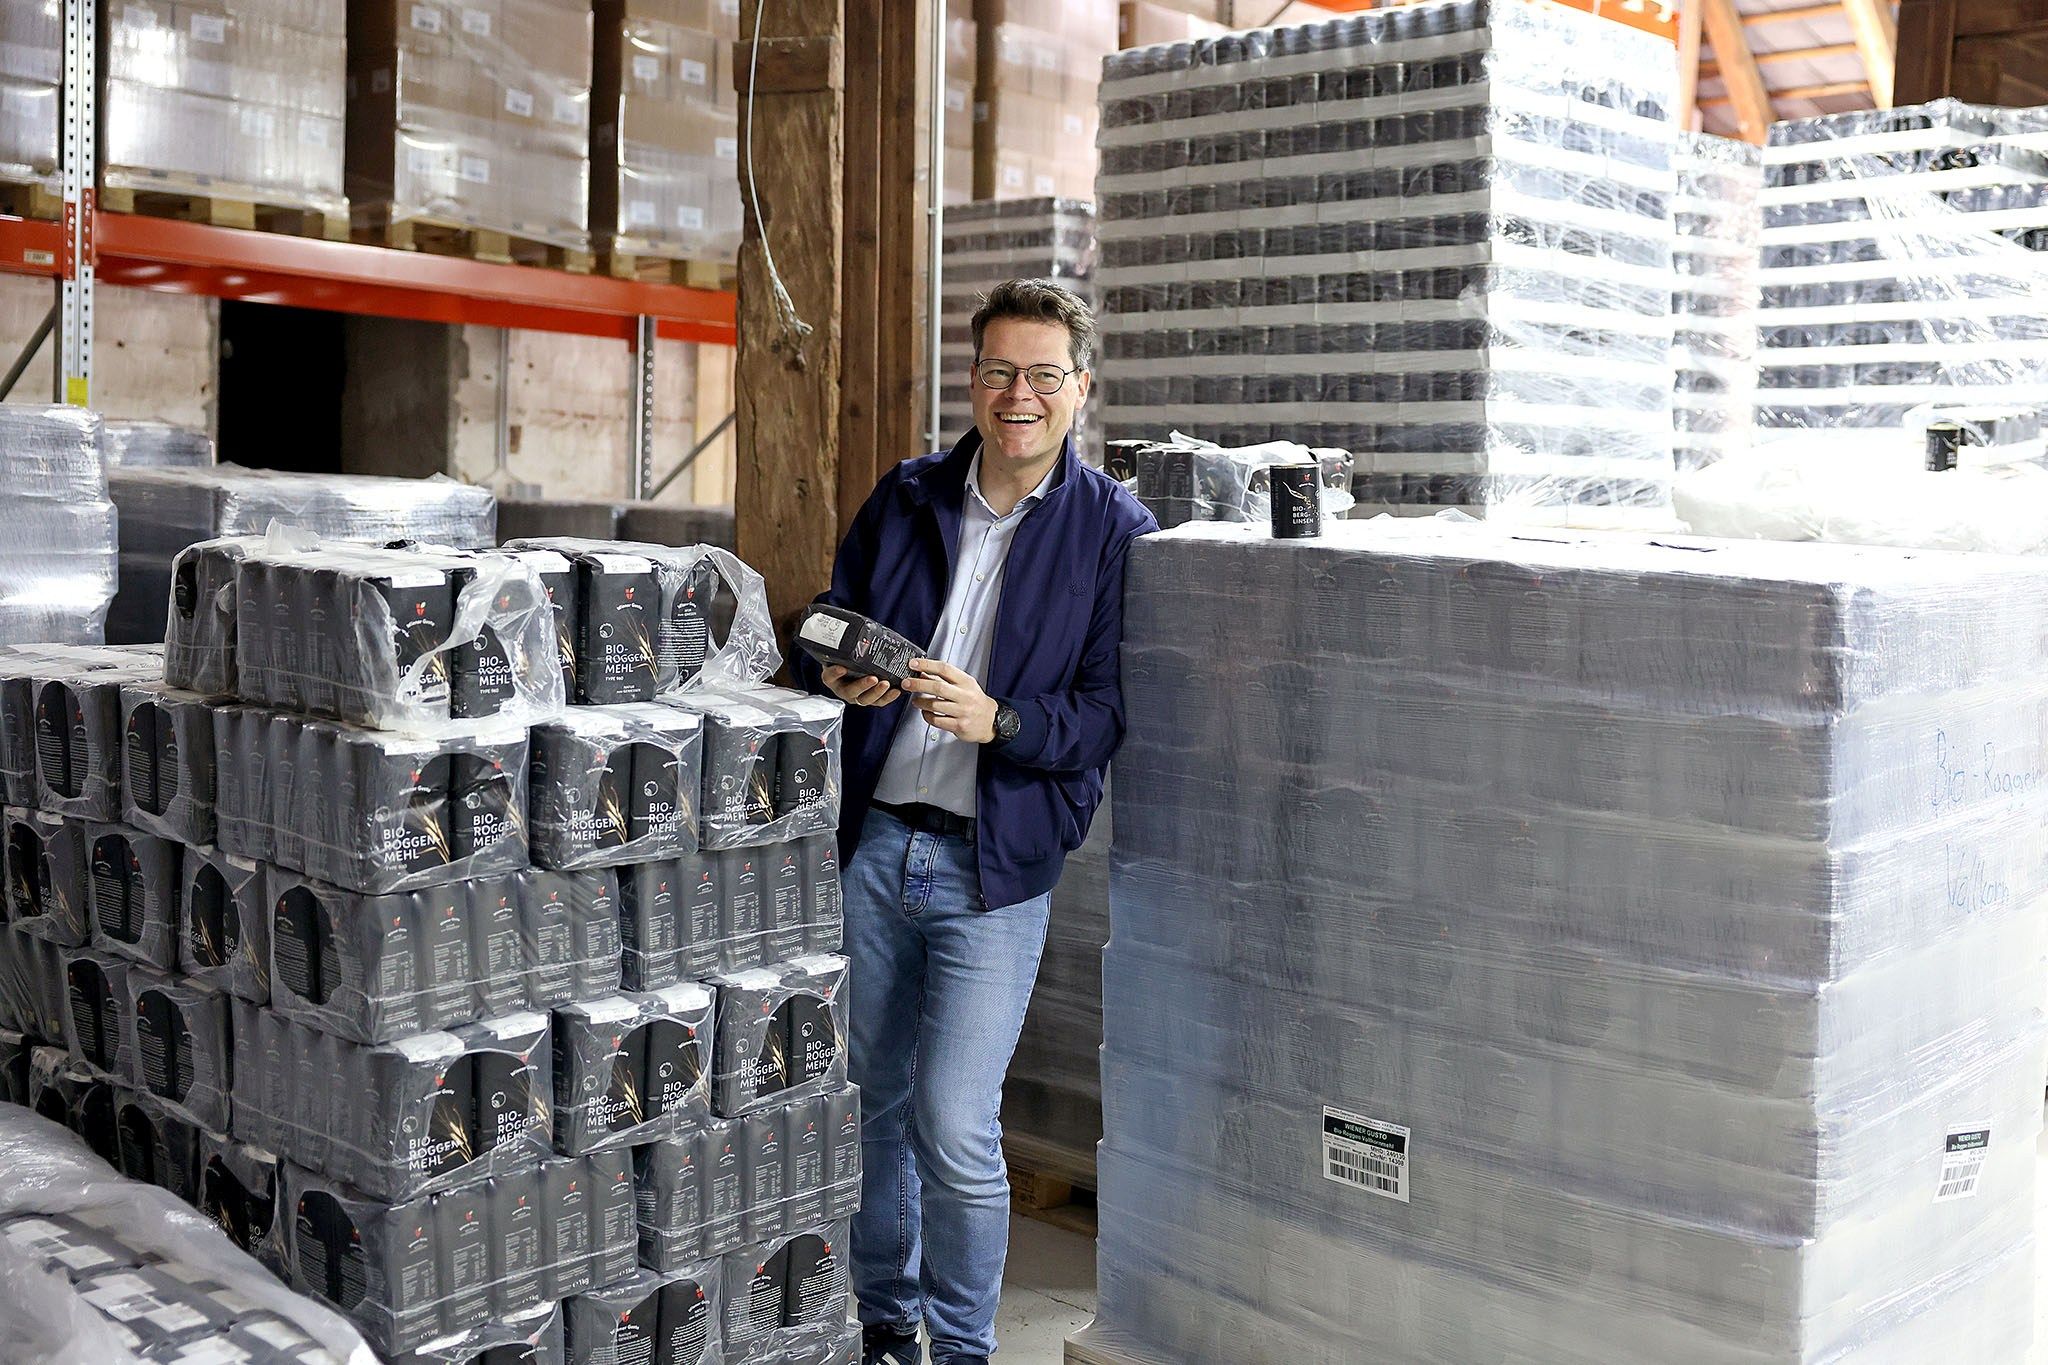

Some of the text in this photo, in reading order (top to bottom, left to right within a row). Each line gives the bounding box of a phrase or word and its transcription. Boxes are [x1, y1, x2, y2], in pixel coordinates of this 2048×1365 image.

[606, 644, 628, 654] BIO-
[480, 656, 503, 667] BIO-
[605, 654, 647, 663] ROGGEN
[605, 664, 634, 674] MEHL
[480, 675, 510, 686] MEHL
[800, 788, 821, 797] BIO-
[650, 802, 673, 813] BIO-
[473, 813, 498, 826] BIO-
[572, 810, 594, 820] BIO-
[724, 812, 750, 822] MEHL
[572, 818, 616, 830] ROGGEN
[648, 822, 678, 834] MEHL
[384, 827, 411, 840] BIO-
[571, 829, 602, 841] MEHL
[384, 834, 438, 851] ROGGEN
[384, 849, 420, 863] MEHL
[807, 1041, 825, 1051] BIO-
[806, 1047, 835, 1061] ROGGE
[742, 1058, 762, 1068] BIO-
[806, 1059, 830, 1071] MEHL
[741, 1064, 780, 1078] ROGGEN
[664, 1082, 685, 1092] BIO-
[740, 1076, 767, 1088] MEHL
[588, 1095, 613, 1106] BIO-
[588, 1100, 630, 1116] ROGGEN
[498, 1111, 522, 1124] BIO-
[587, 1115, 616, 1127] MEHL
[1345, 1123, 1366, 1134] WIENER
[1367, 1129, 1387, 1140] GUSTO
[409, 1136, 436, 1149] BIO-
[1342, 1129, 1361, 1140] Roggen
[1362, 1135, 1394, 1149] Vollkornmehl
[409, 1141, 460, 1161] ROGGEN
[408, 1154, 444, 1170] MEHL
